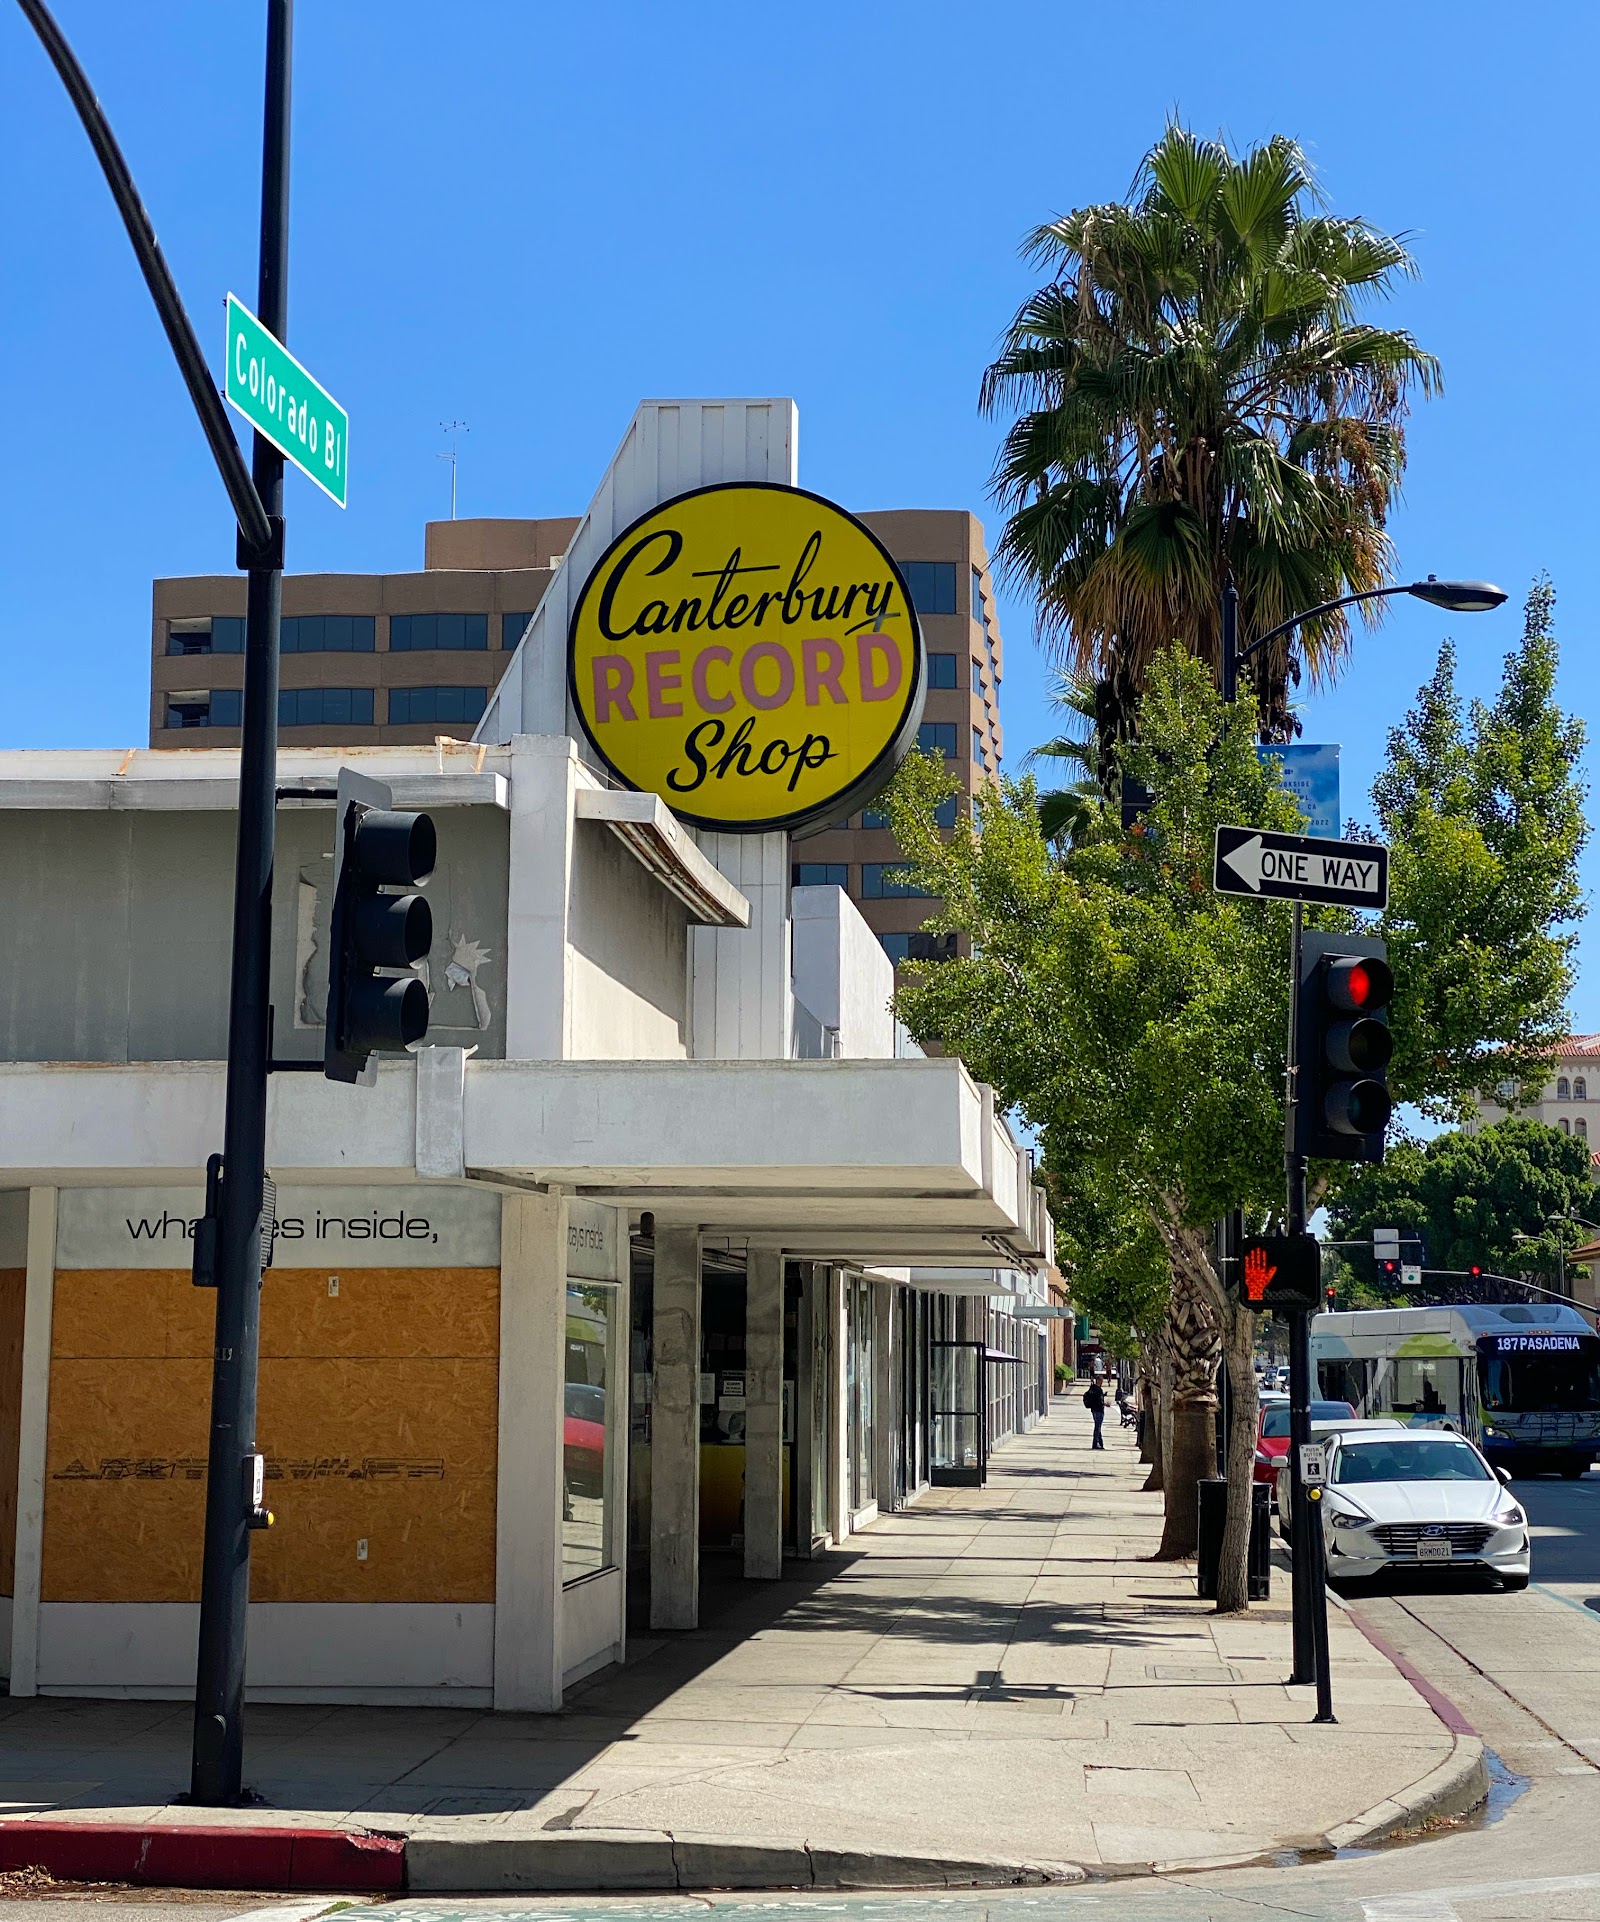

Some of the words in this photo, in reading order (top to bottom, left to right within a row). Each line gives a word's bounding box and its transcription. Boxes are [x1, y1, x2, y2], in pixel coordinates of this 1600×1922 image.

[235, 332, 318, 454] Colorado
[324, 419, 340, 477] Bl
[598, 529, 901, 641] Canterbury
[591, 632, 903, 724] RECORD
[666, 715, 837, 793] Shop
[1261, 851, 1309, 883] ONE
[1322, 858, 1374, 889] WAY
[316, 1210, 439, 1244] inside,
[1497, 1337, 1519, 1351] 187
[1519, 1336, 1581, 1351] PASADENA
